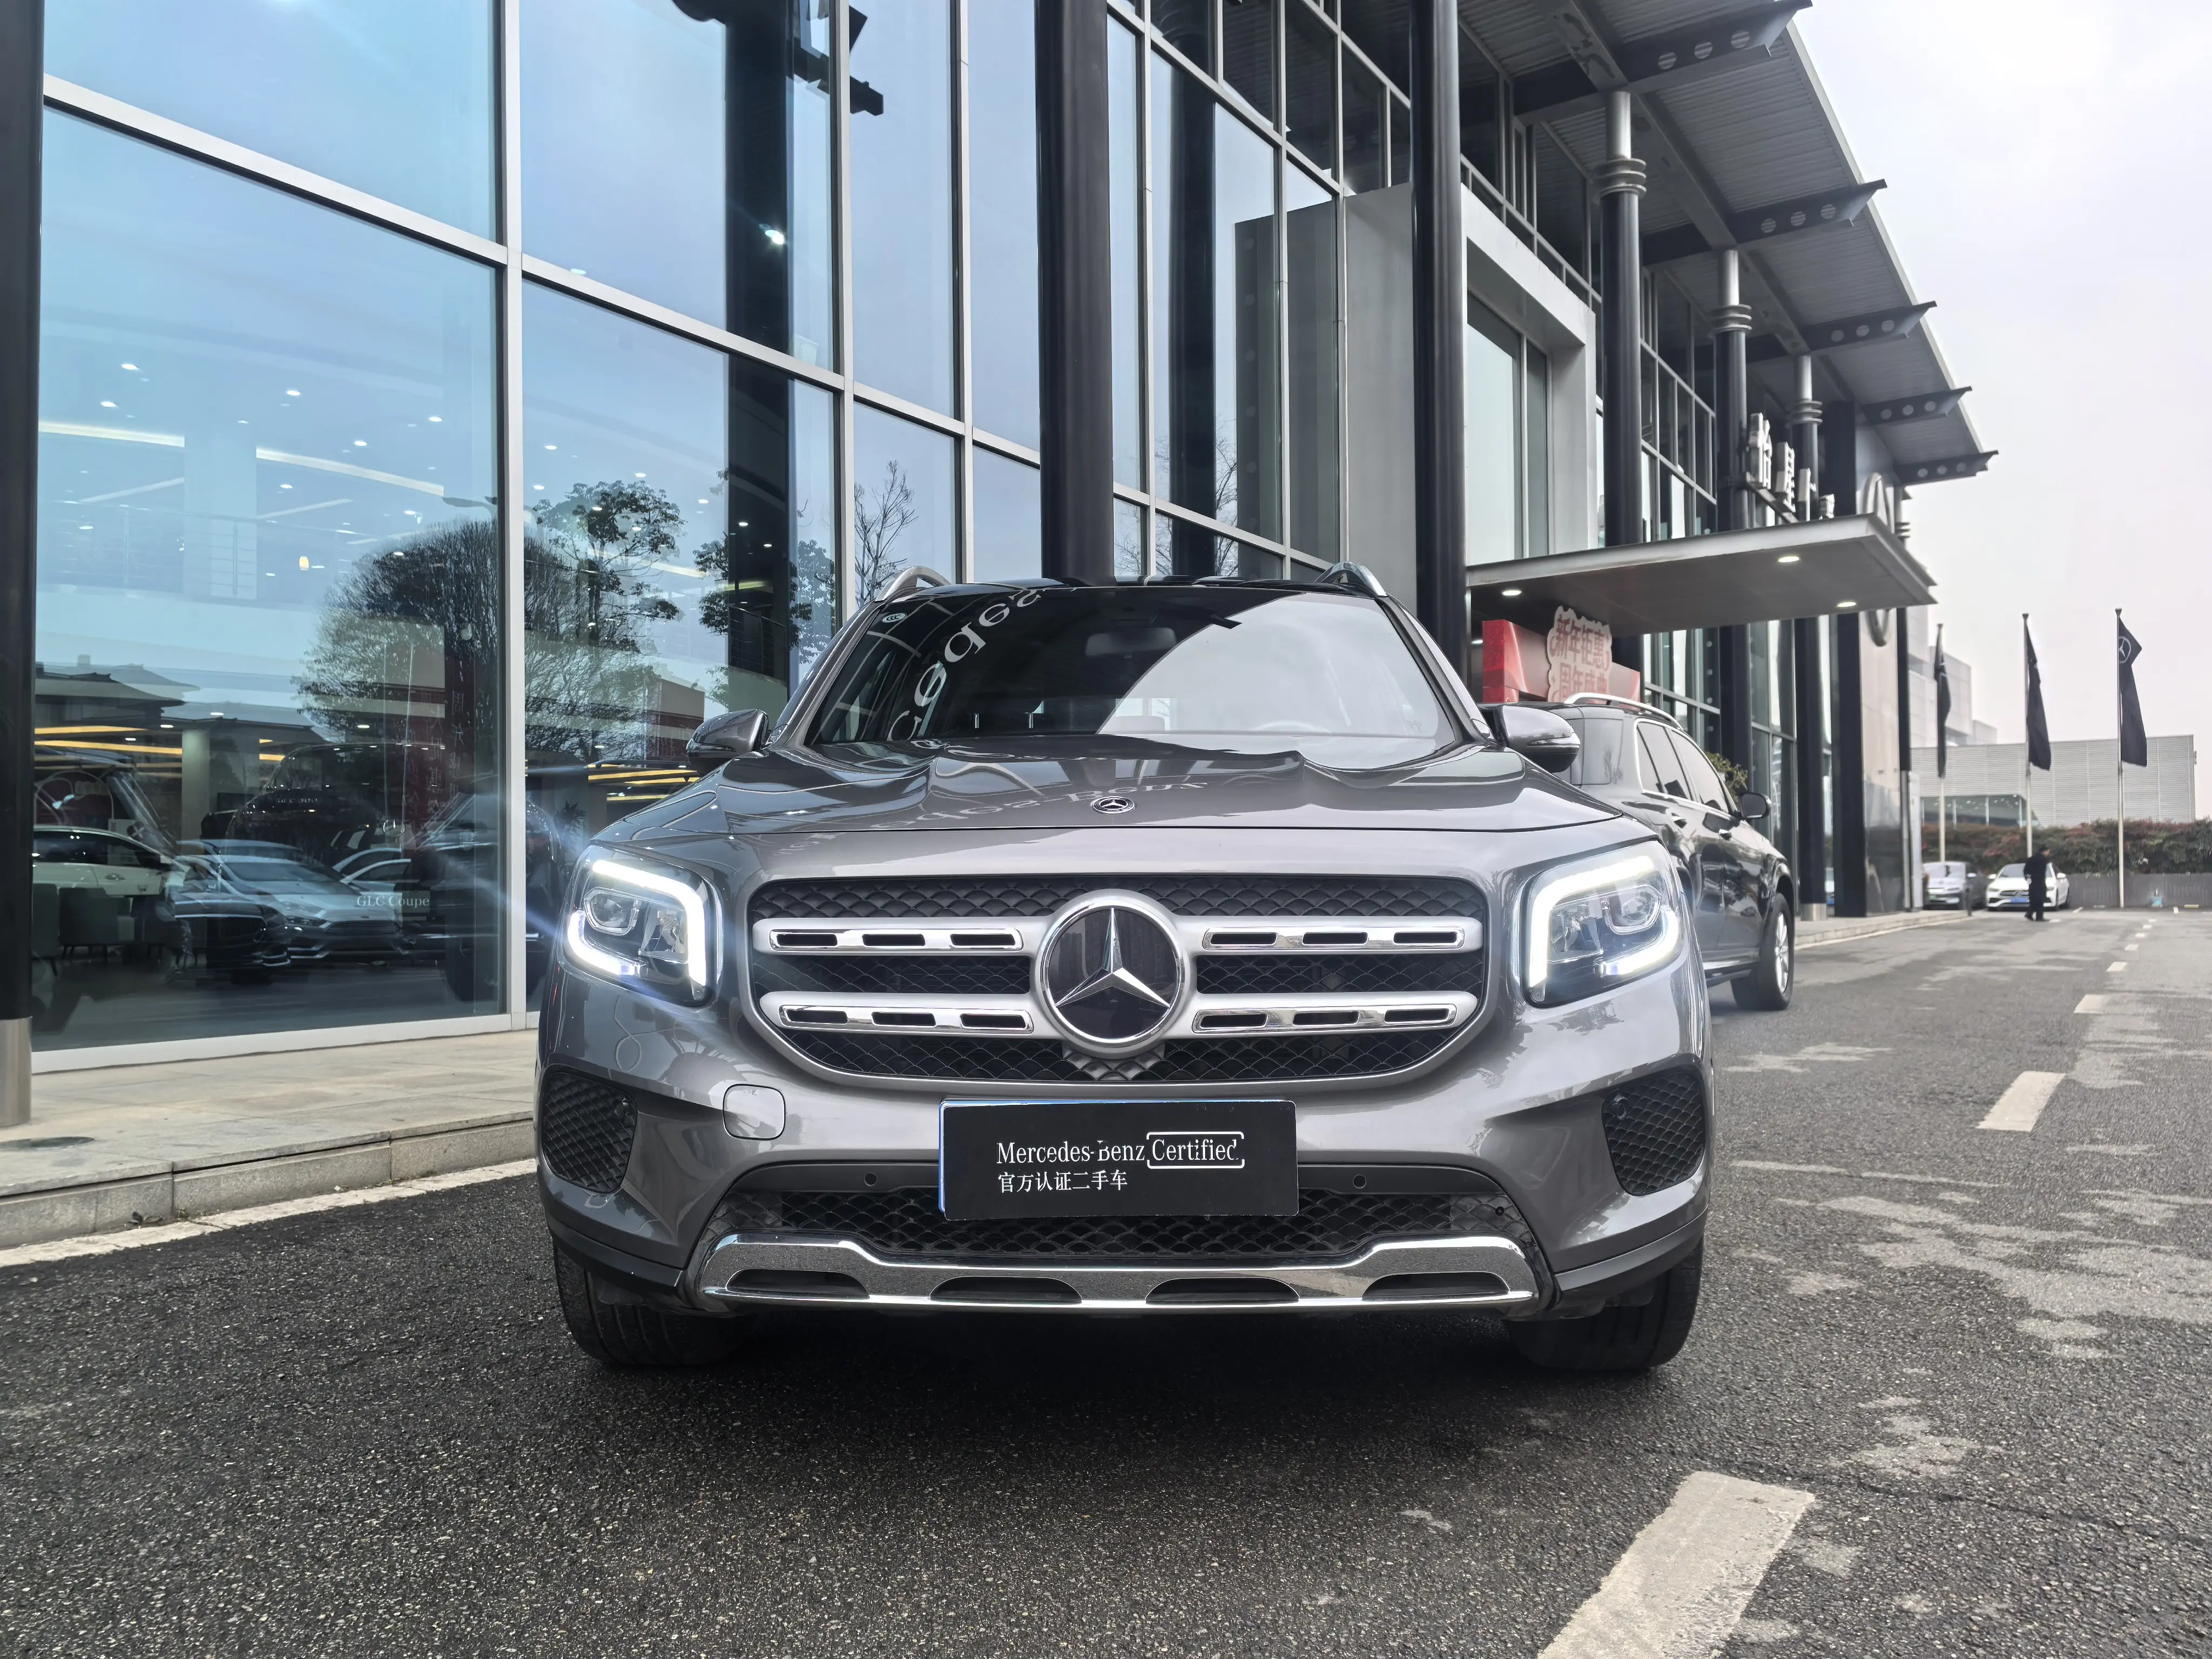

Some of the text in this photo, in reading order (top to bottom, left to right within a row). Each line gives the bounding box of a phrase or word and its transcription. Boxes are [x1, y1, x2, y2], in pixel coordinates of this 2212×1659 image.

[357, 895, 430, 908] GLC Coupe
[996, 1139, 1239, 1164] Mercedes-Benz Certified
[998, 1169, 1128, 1193] 官方认证二手车
